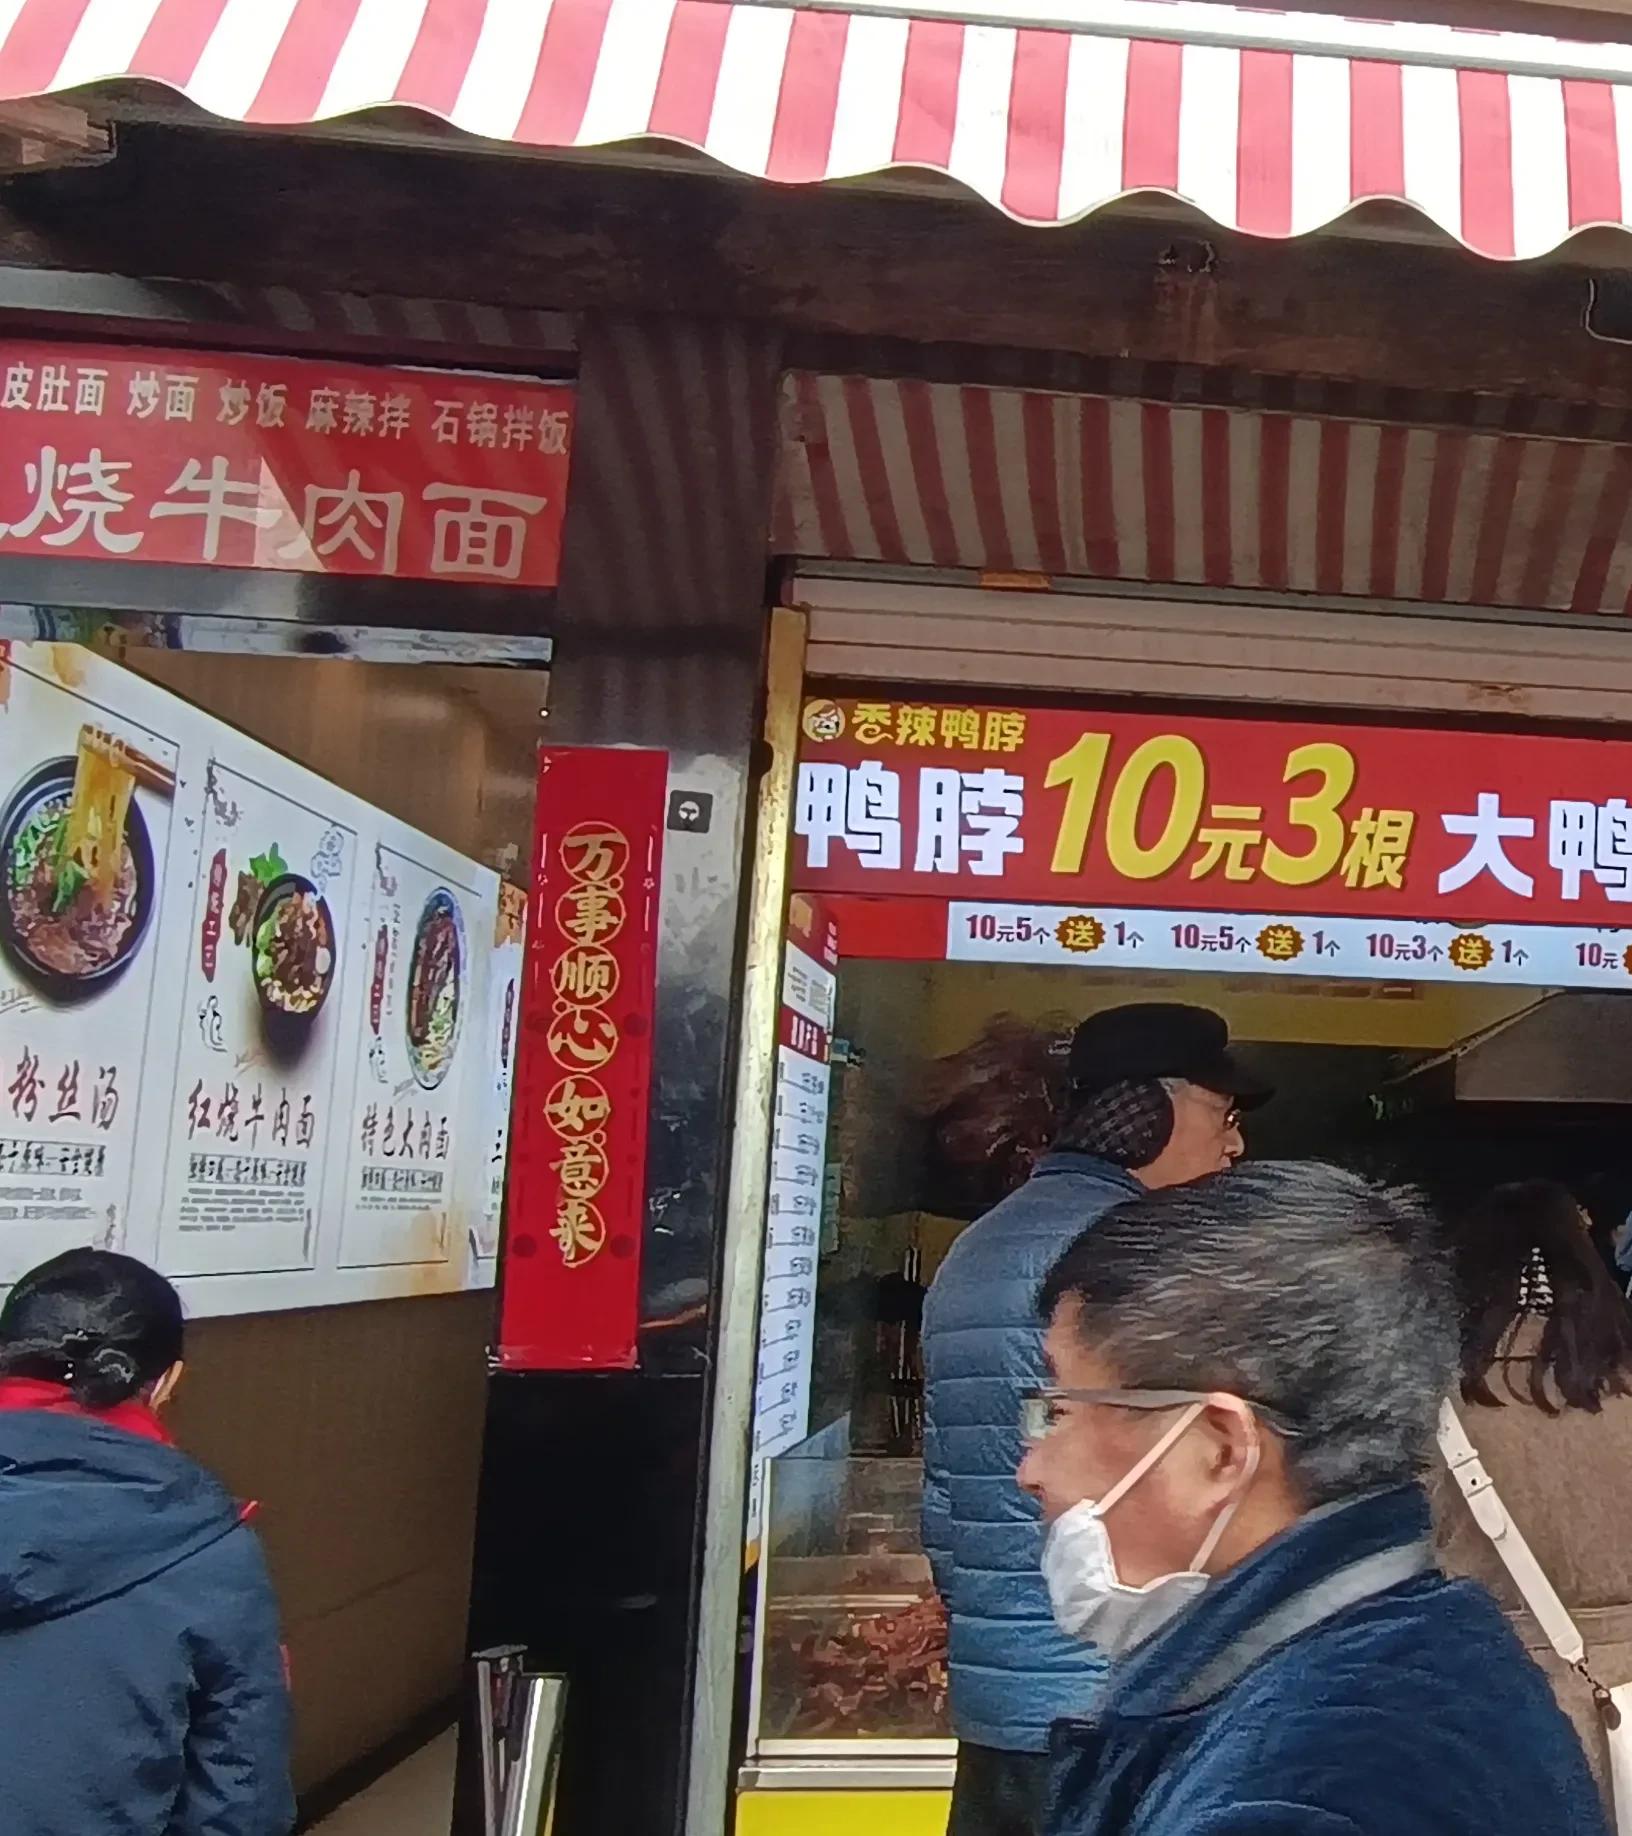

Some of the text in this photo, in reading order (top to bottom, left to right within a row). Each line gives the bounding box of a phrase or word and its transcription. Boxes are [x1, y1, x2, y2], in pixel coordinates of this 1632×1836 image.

[3, 361, 569, 457] 皮肚面 炒面 炒饭 麻辣拌 石锅拌饭
[0, 445, 548, 580] 烧牛肉面
[852, 701, 1026, 753] 香辣鸭脖
[794, 759, 1025, 877] 鸭脖
[1043, 731, 1414, 890] 10元3根
[8, 1045, 119, 1130] 粉丝汤
[547, 822, 630, 1267] 万事顺心如意来
[188, 1078, 315, 1150] 红烧牛肉面
